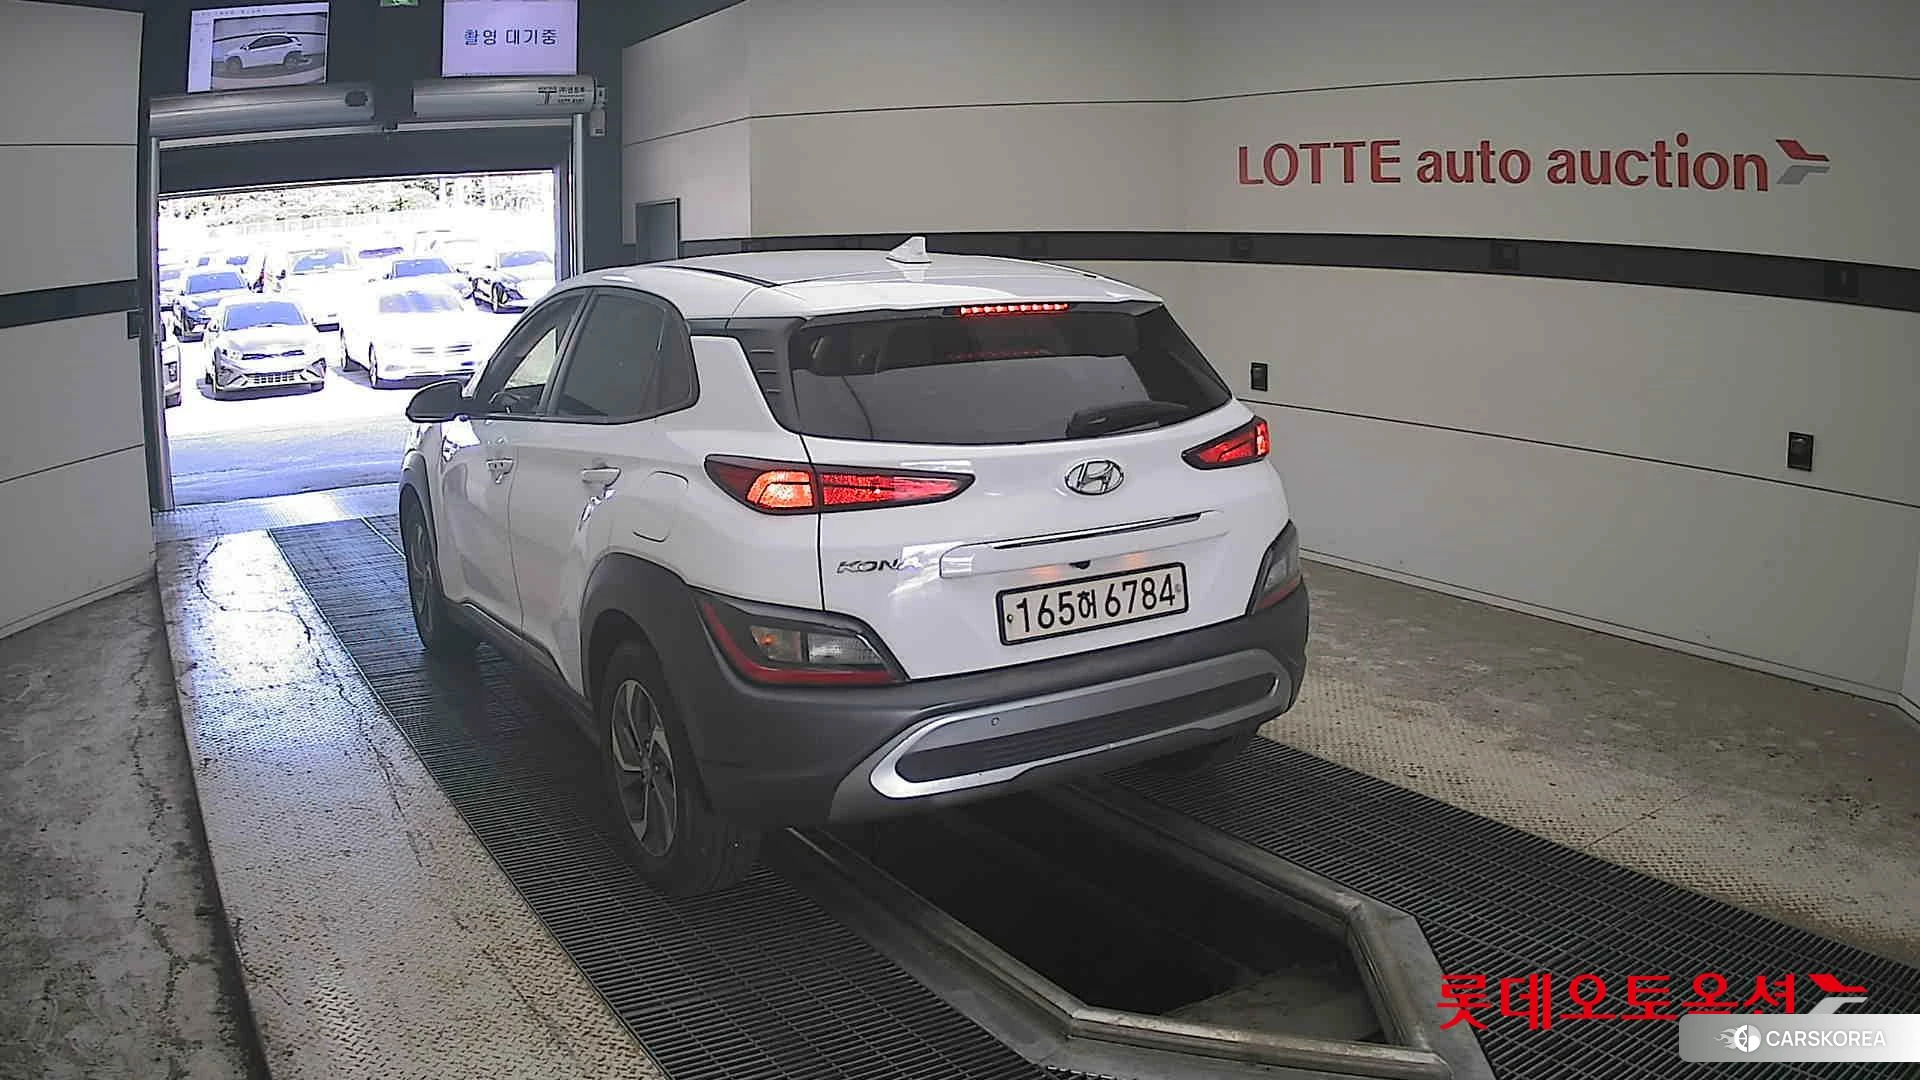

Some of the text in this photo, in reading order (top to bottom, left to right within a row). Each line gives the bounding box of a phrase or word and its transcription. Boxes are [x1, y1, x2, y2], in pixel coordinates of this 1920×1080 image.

[464, 28, 558, 46] 촬영 대기중
[1238, 132, 1769, 192] LOTTE auto auction
